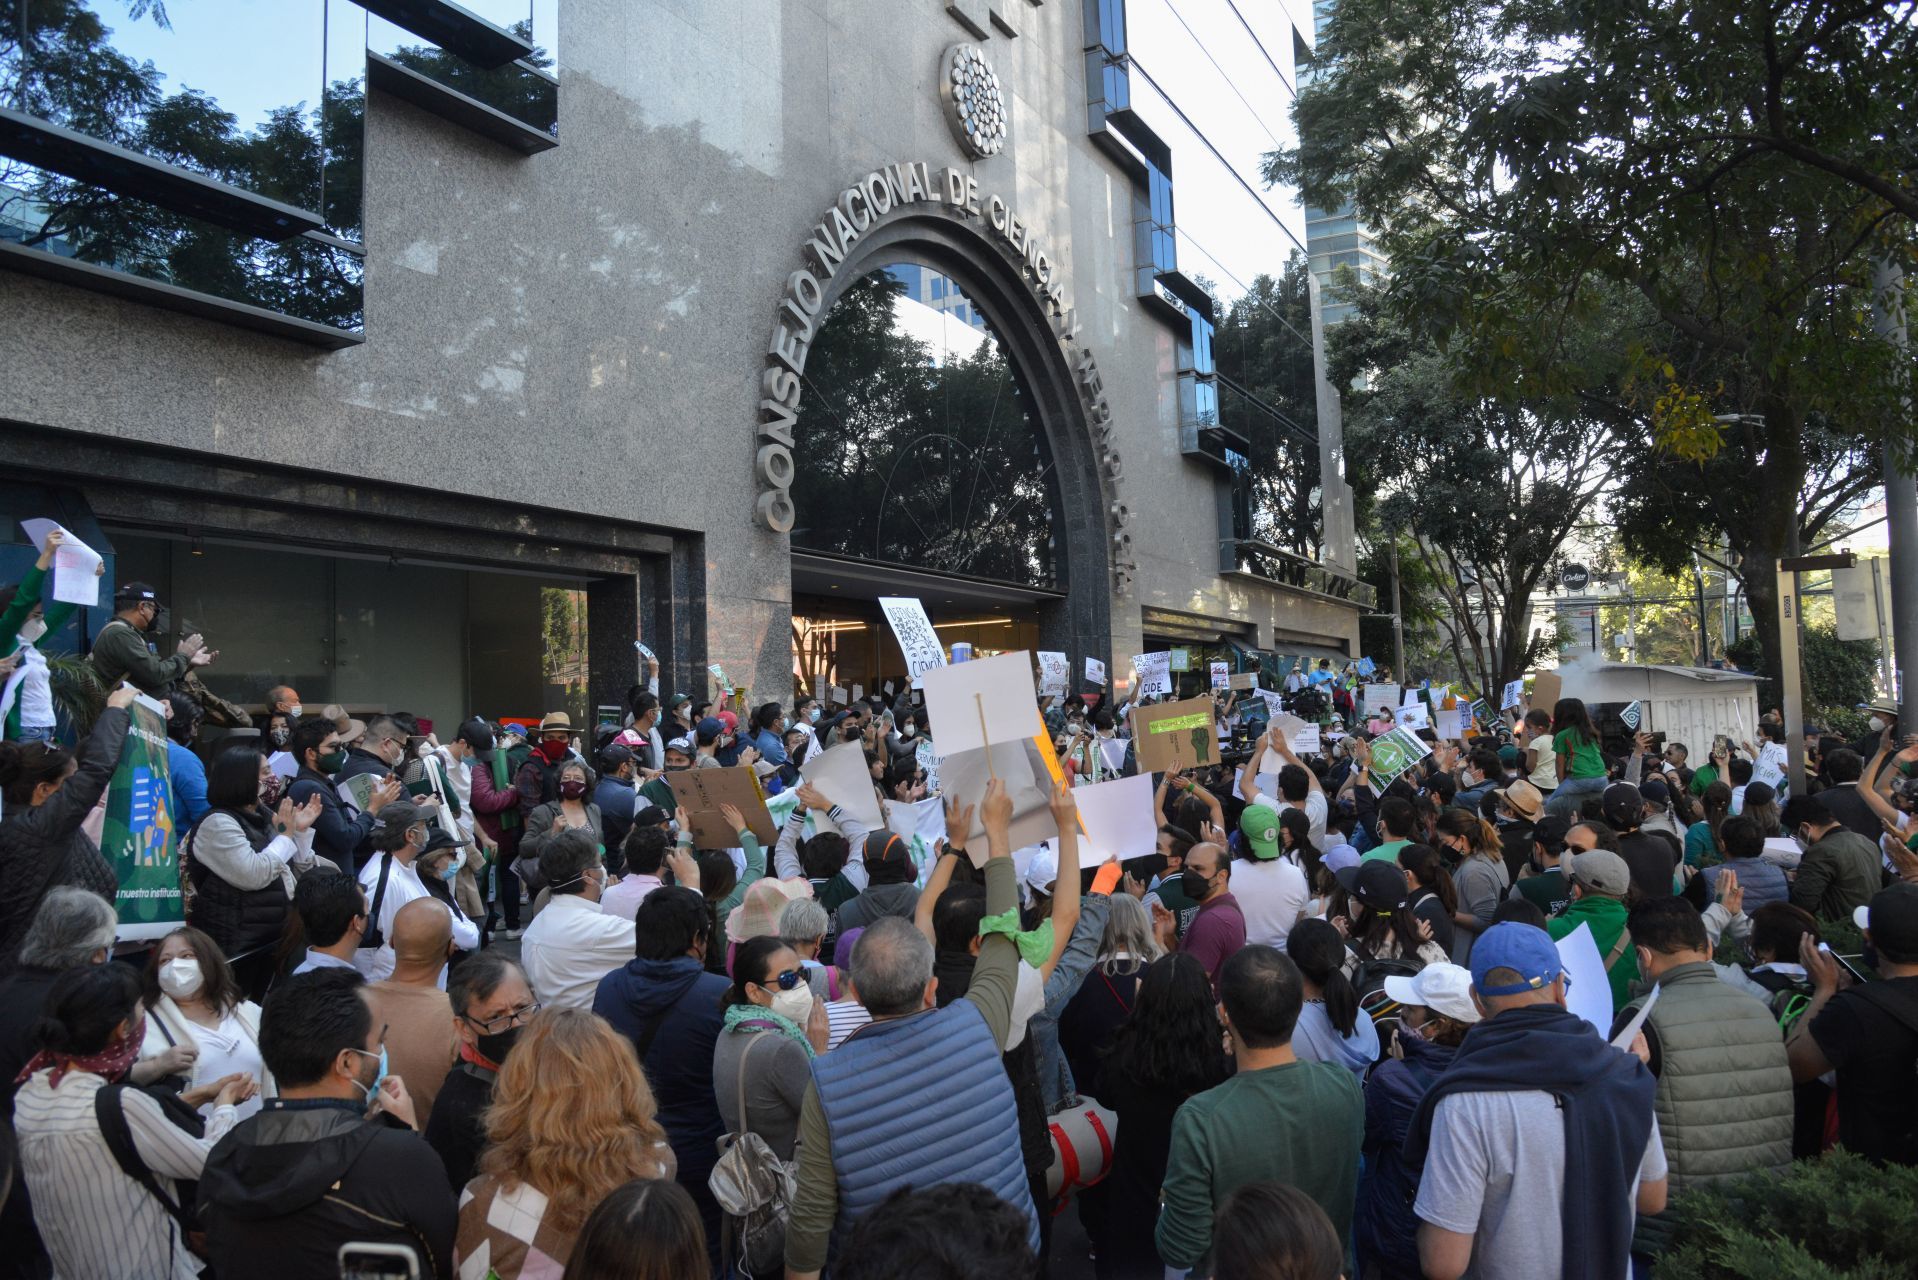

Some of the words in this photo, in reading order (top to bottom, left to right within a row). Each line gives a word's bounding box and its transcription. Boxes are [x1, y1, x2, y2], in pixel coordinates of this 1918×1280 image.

[757, 269, 823, 533] CONSEJO
[806, 161, 941, 279] NACIONAL
[941, 166, 980, 217] DE
[984, 193, 1065, 318] CIENCIA
[1143, 682, 1163, 693] CIDE
[121, 888, 150, 898] nuestra
[150, 886, 181, 898] institución
